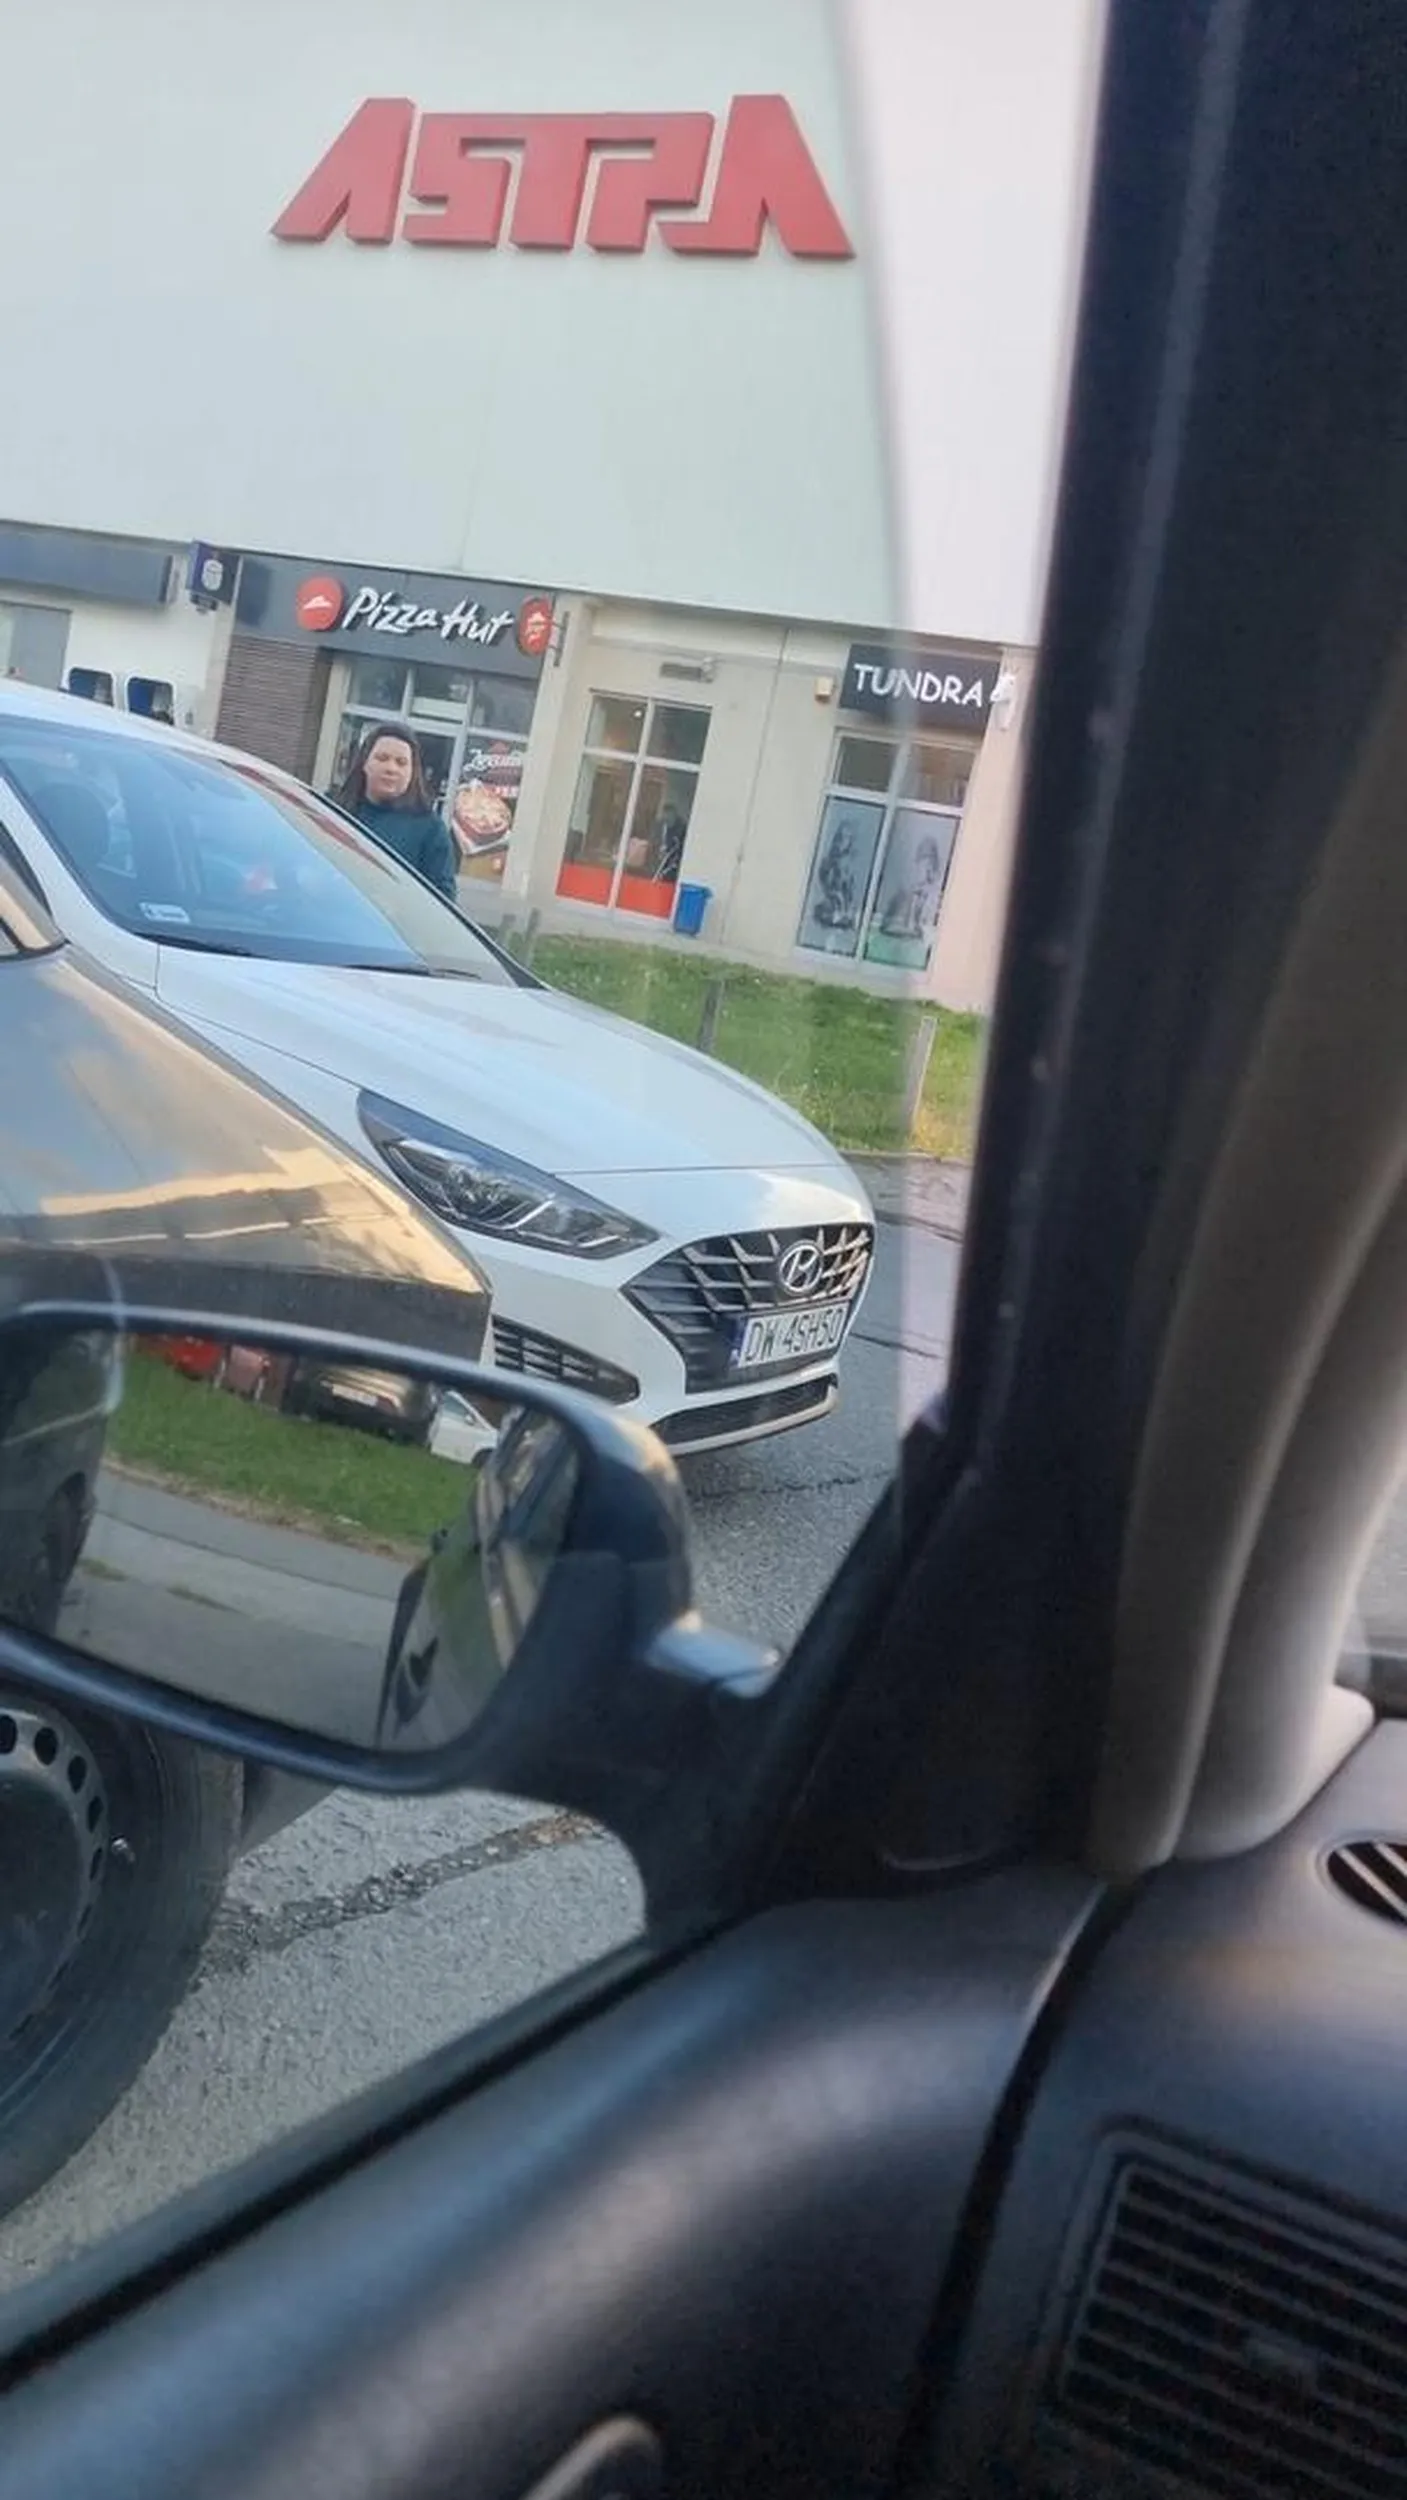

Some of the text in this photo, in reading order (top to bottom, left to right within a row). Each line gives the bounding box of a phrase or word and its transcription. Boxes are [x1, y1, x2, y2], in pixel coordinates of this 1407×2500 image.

[270, 94, 856, 259] ASTRA
[342, 587, 514, 644] Pizza Hut
[854, 663, 984, 708] TUNDRA
